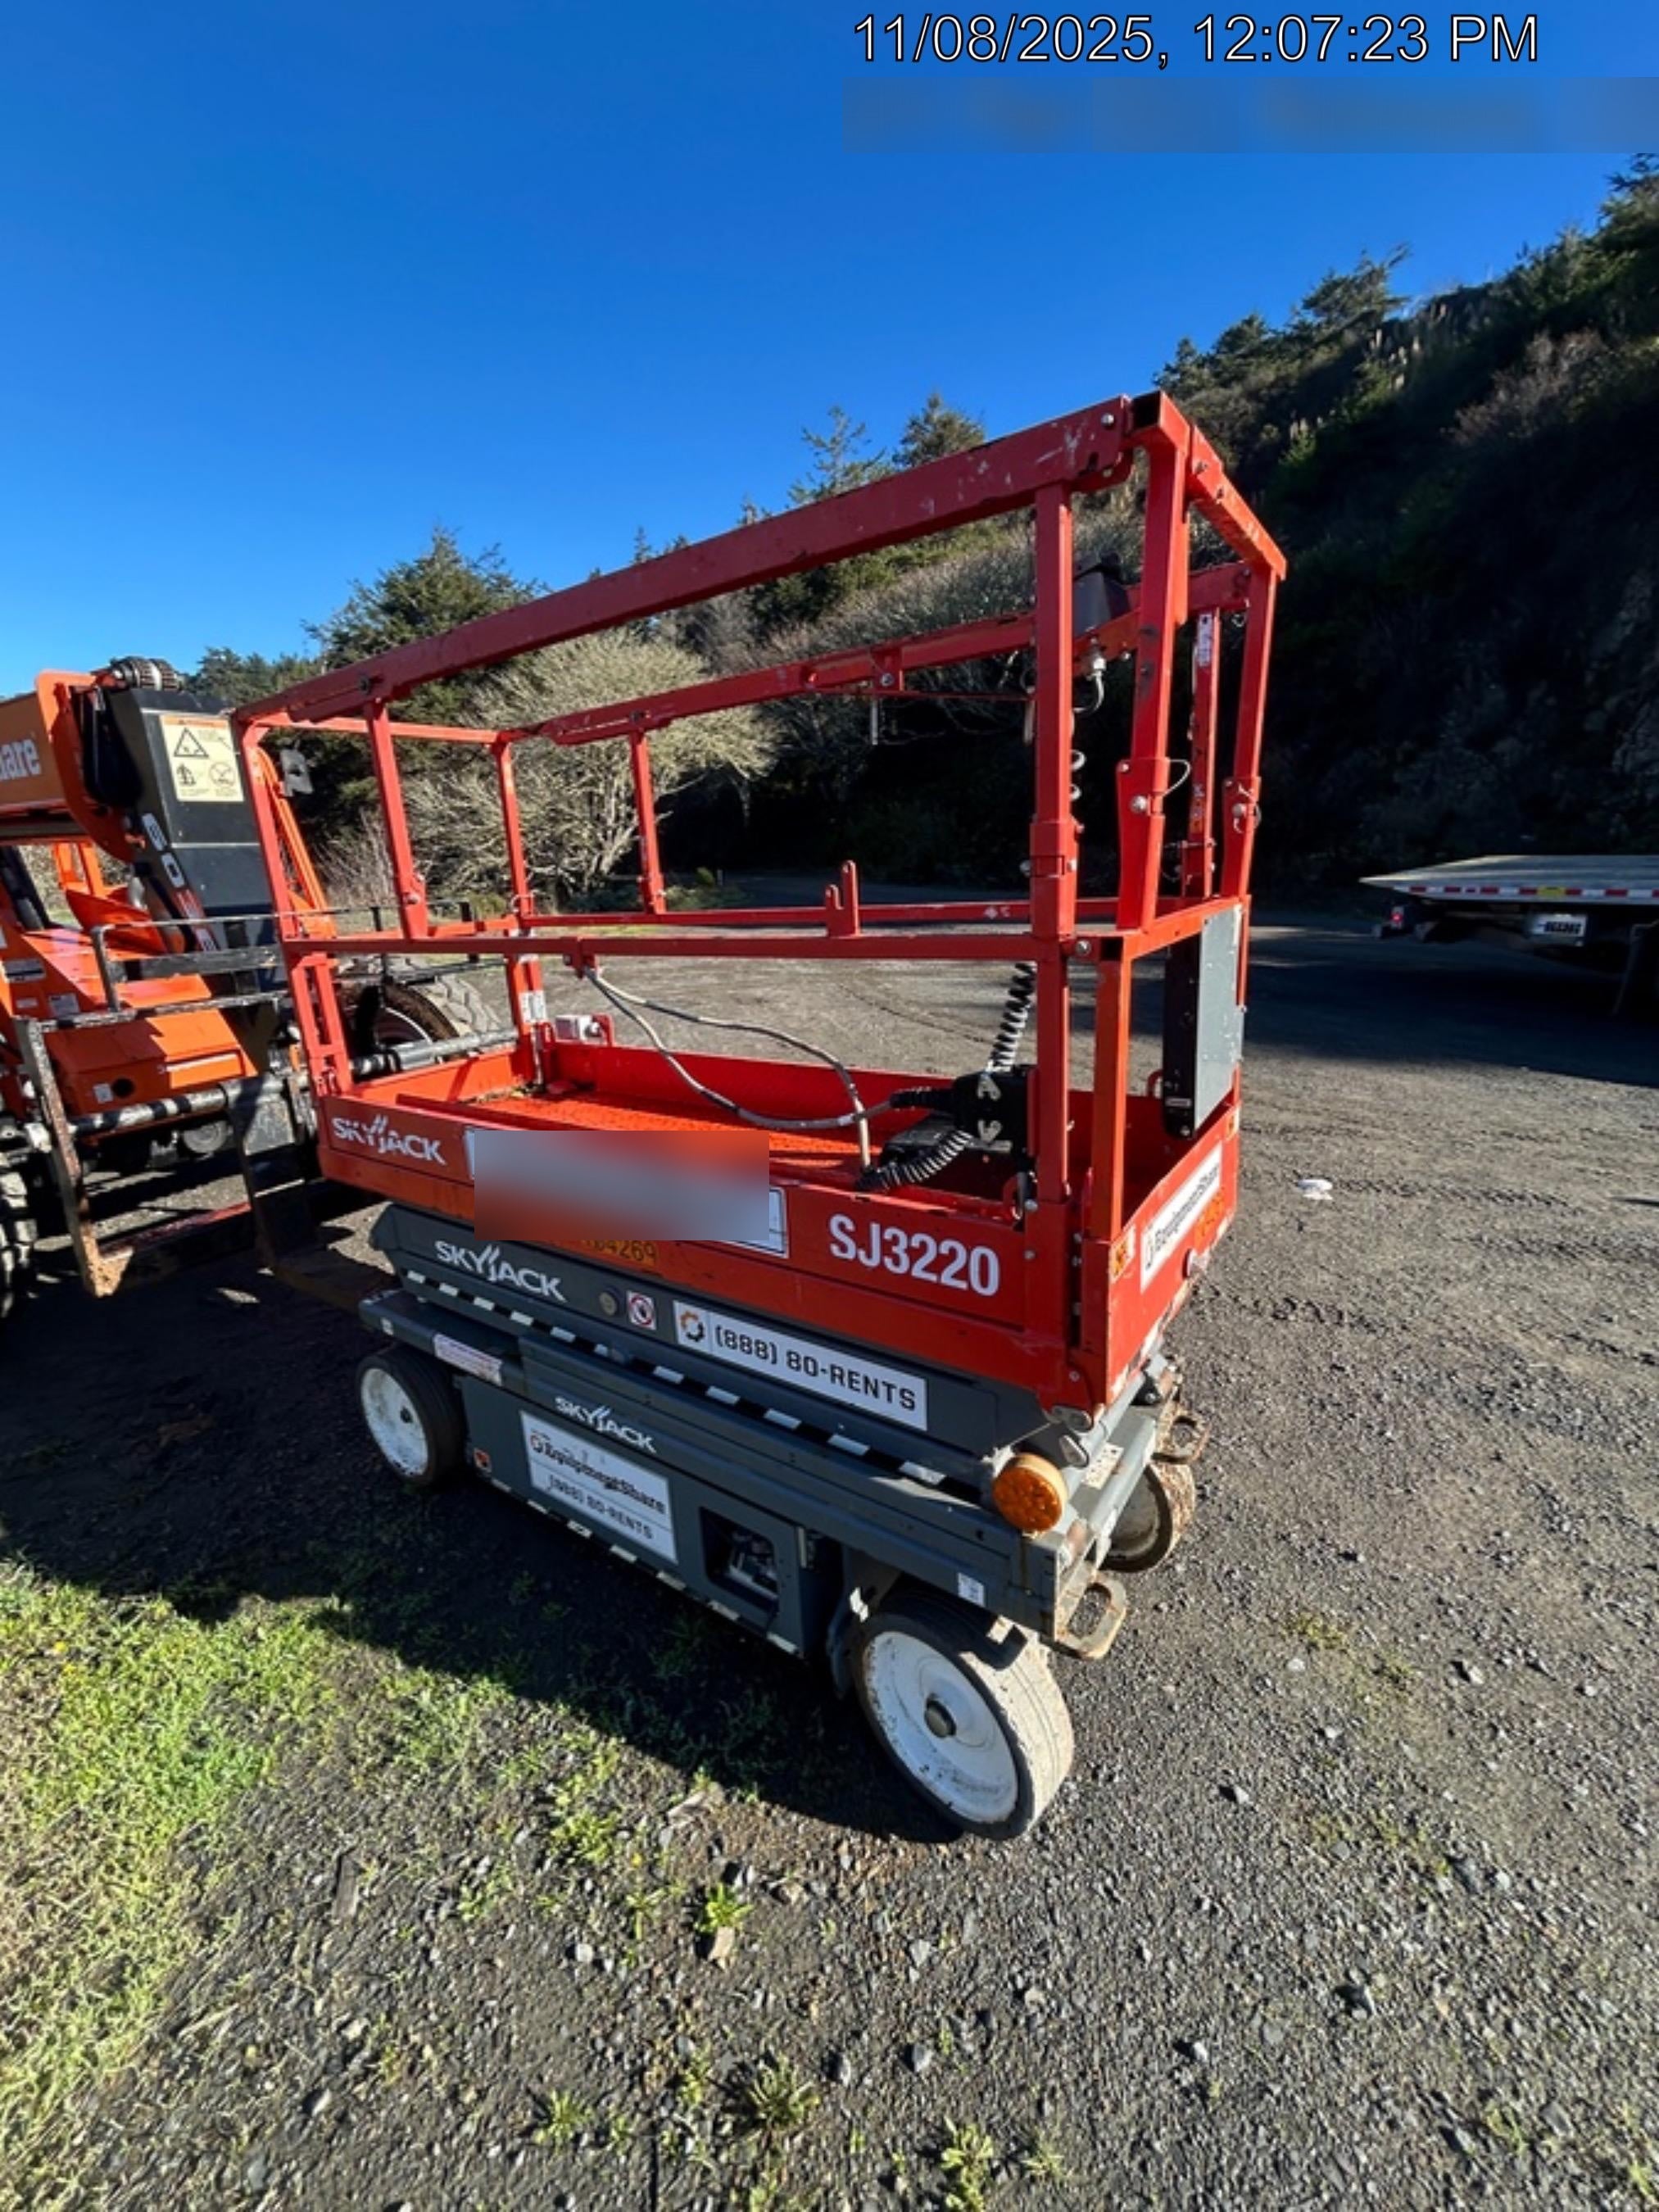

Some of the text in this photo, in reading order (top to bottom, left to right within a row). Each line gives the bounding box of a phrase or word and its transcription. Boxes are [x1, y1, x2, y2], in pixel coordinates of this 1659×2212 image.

[331, 1113, 447, 1167] SKYJACK
[434, 1240, 569, 1303] SKYJACK
[829, 1213, 999, 1297] SJ3220
[714, 1325, 916, 1412] (888) 80-RENTS
[555, 1396, 657, 1454] SKYJACK
